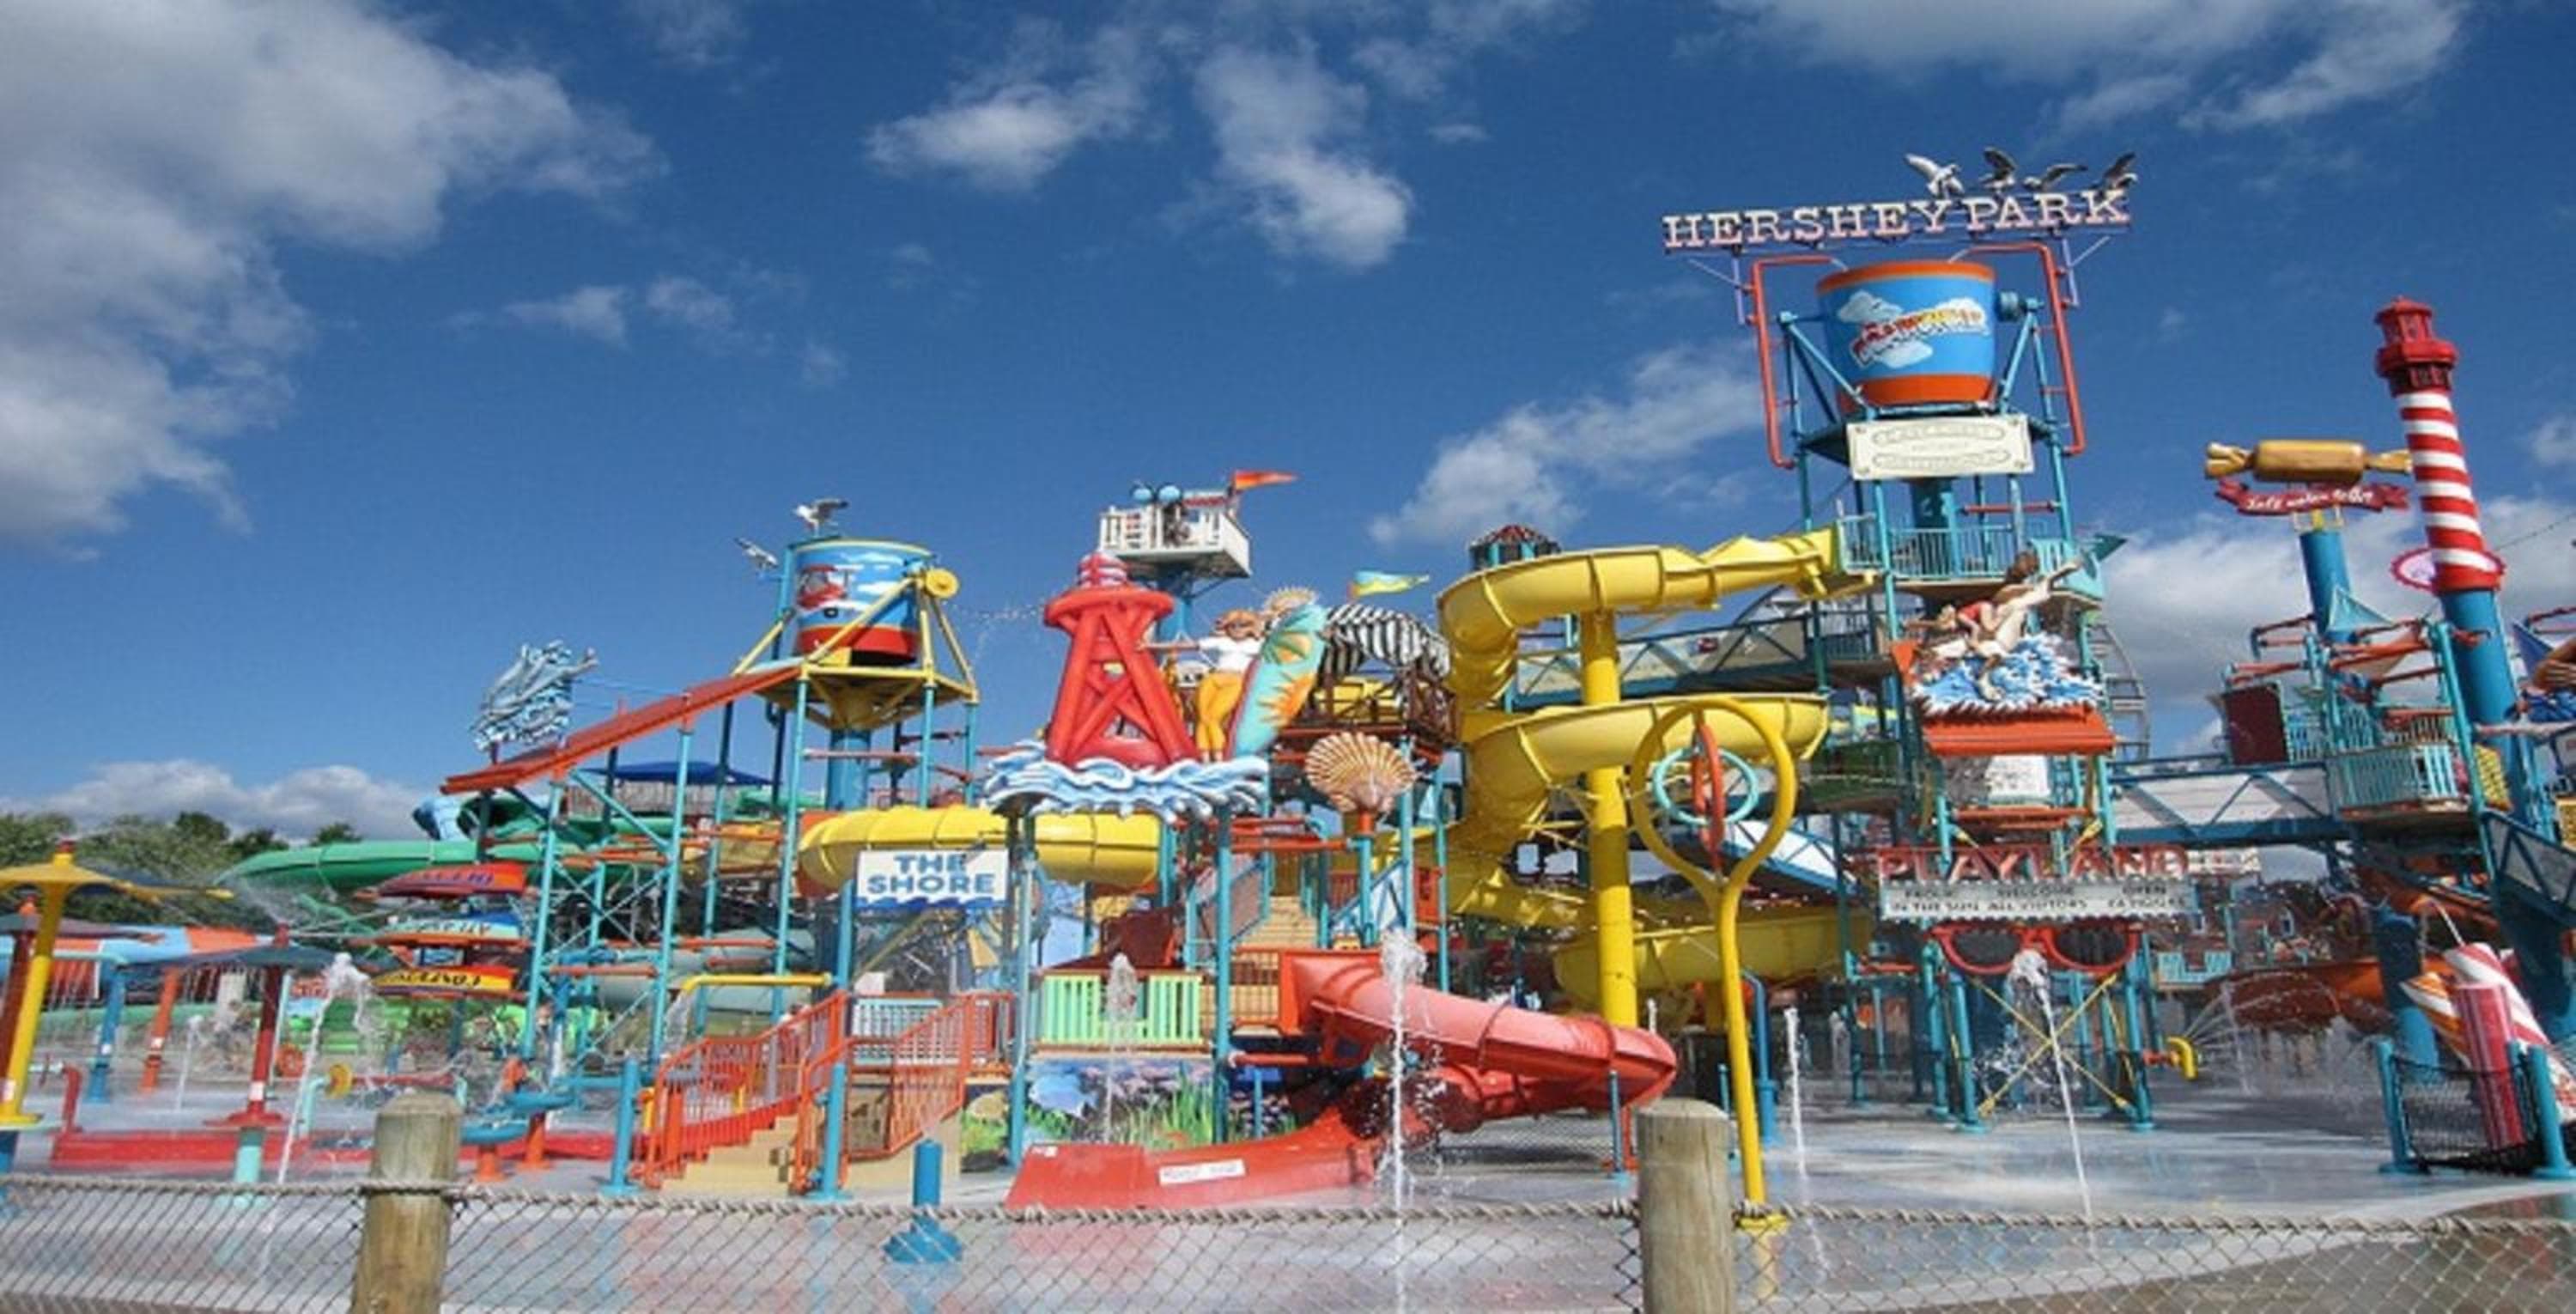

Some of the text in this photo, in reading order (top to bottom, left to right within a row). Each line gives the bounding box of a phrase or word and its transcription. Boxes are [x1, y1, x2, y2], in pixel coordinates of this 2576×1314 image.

[893, 854, 966, 873] THE
[1878, 844, 2188, 881] PLAYLAND
[867, 873, 995, 894] SHORE
